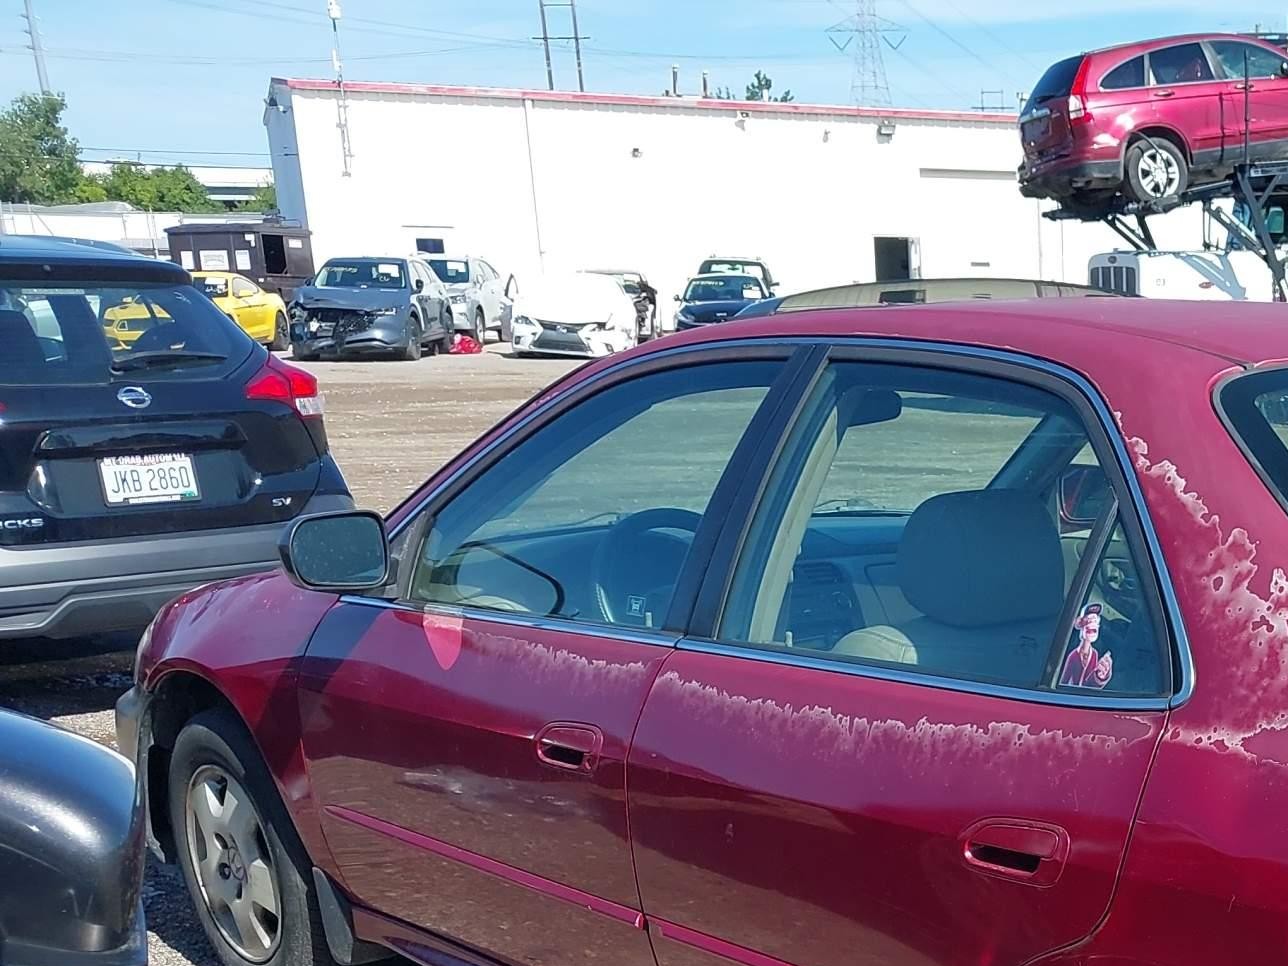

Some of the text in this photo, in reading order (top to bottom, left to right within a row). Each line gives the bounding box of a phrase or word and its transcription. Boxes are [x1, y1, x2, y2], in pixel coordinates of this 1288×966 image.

[112, 466, 191, 493] JKB 2860
[272, 497, 292, 507] SV
